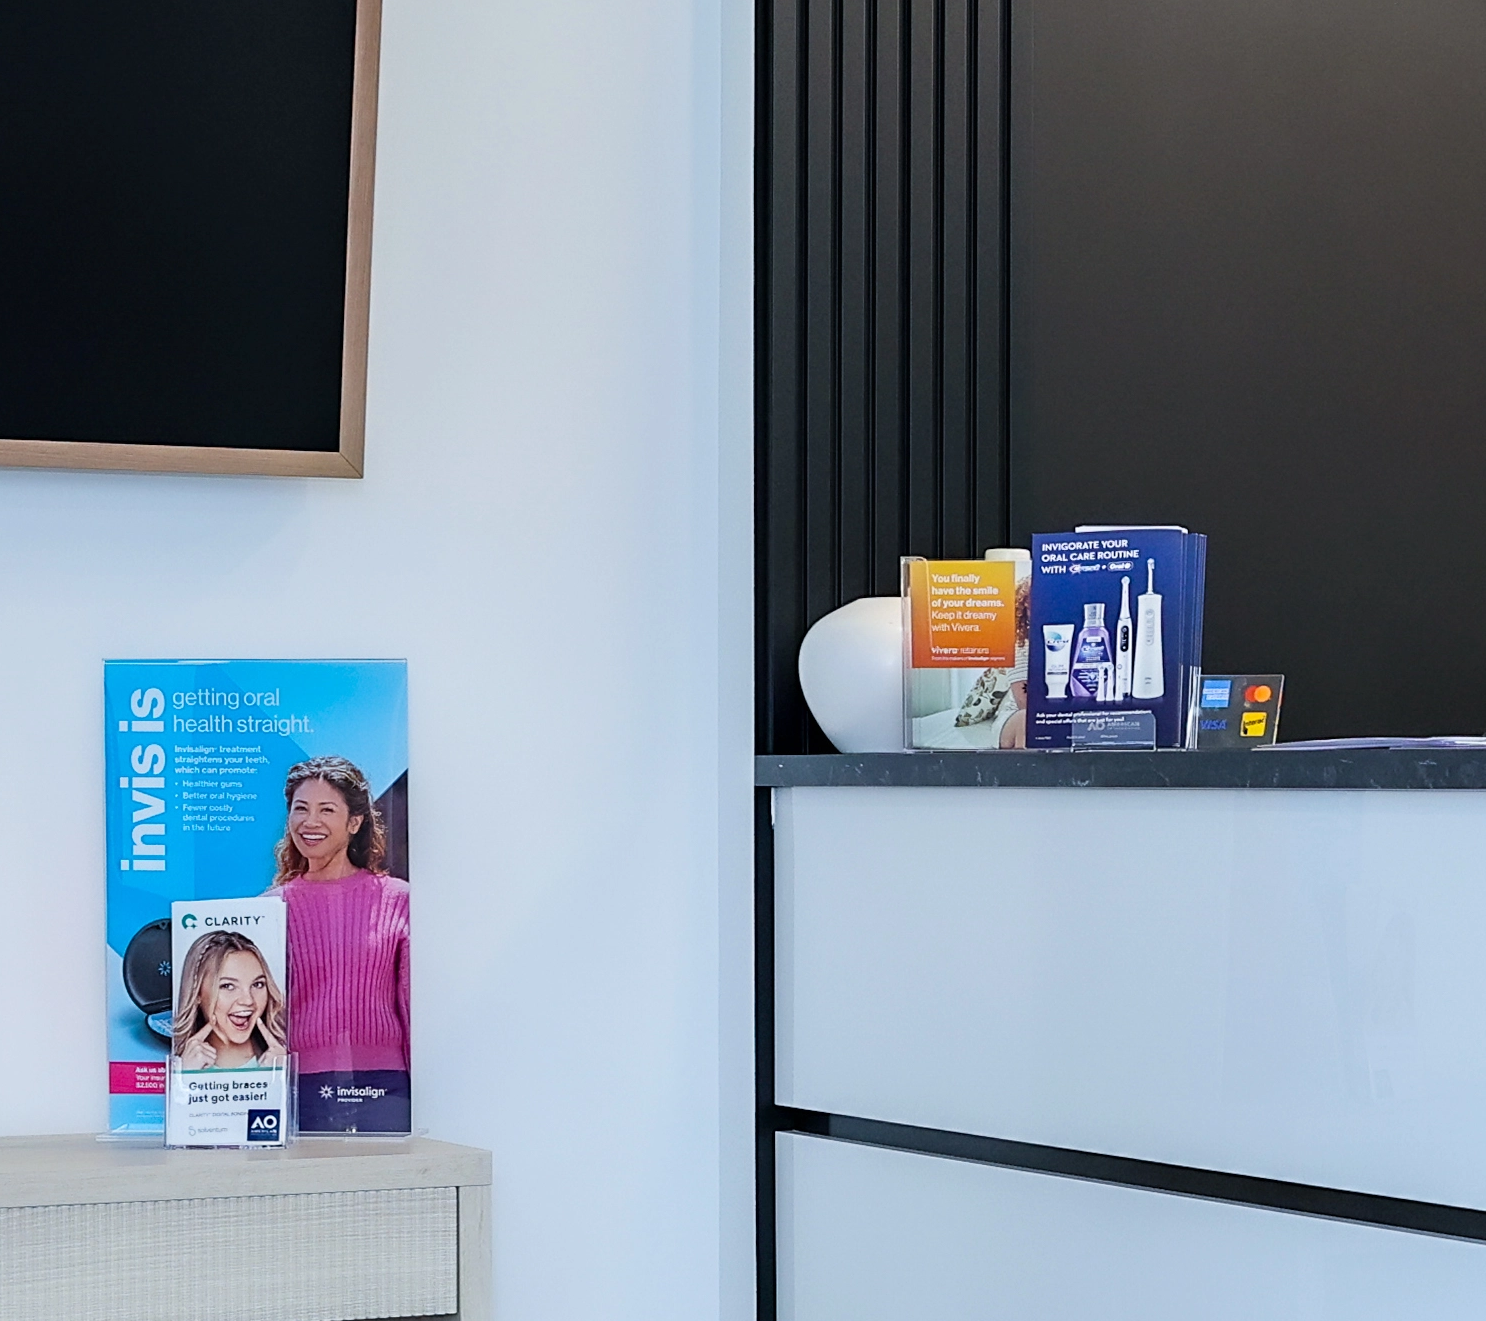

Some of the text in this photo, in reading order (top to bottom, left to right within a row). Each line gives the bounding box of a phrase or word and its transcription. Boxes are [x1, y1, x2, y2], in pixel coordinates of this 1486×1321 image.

[1041, 539, 1128, 552] INVIGORATE YOUR
[1041, 549, 1140, 562] ORAL CARE ROUTINE
[1041, 565, 1066, 574] WITH
[932, 573, 980, 584] You finally
[931, 586, 999, 595] have the smile
[931, 598, 1005, 609] of your dreams.
[932, 610, 997, 621] Keep it dreamy
[931, 623, 981, 632] with Vivera.
[172, 688, 280, 710] getting oral
[173, 714, 315, 737] health straight.
[1200, 719, 1228, 730] VISA
[219, 745, 261, 753] treatment
[174, 756, 270, 765] straightens your teeth,
[174, 766, 200, 774] which
[118, 687, 166, 871] invis is
[182, 791, 207, 799] Better
[226, 792, 258, 801] hygiene
[182, 803, 233, 812] Fewer costly
[209, 814, 255, 822] procedures
[182, 823, 231, 831] in the future
[204, 915, 261, 926] CLARITY
[188, 1081, 268, 1092] Getting braces
[188, 1091, 268, 1105] just got easier!
[336, 1086, 385, 1099] invisalign
[250, 1115, 278, 1130] AO
